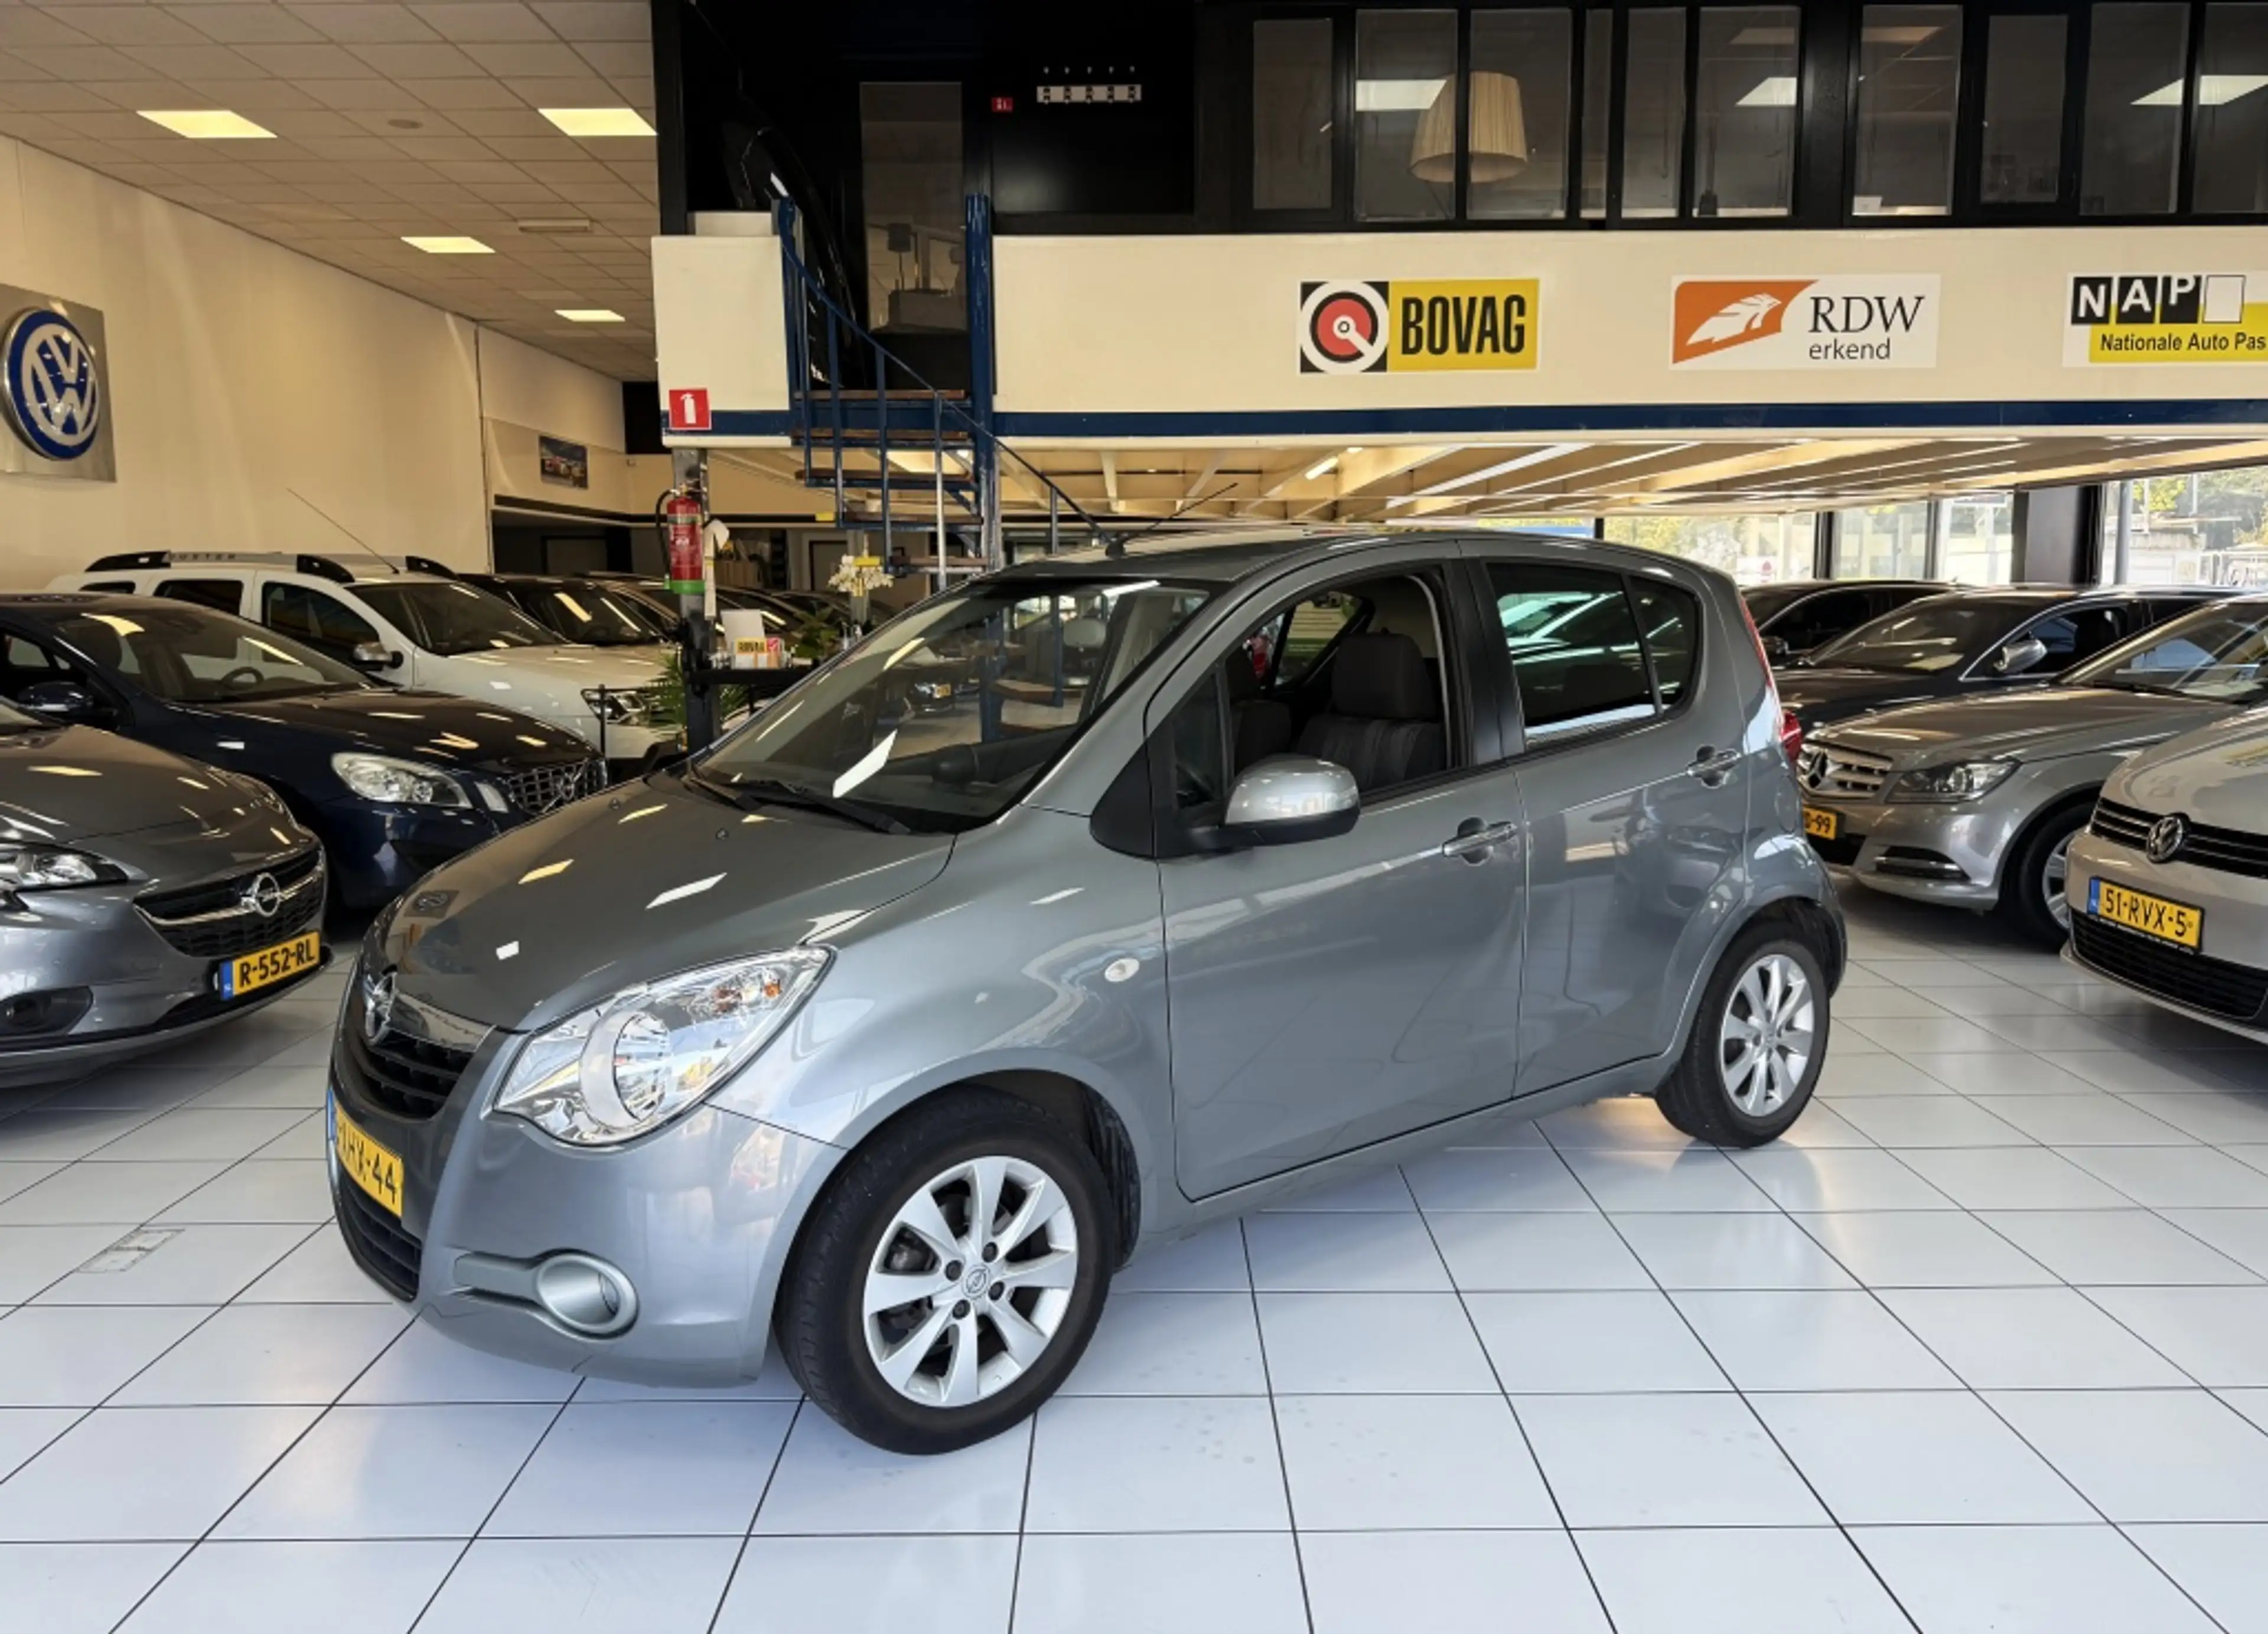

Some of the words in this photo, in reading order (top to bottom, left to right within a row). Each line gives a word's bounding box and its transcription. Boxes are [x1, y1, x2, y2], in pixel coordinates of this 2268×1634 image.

[1808, 296, 1925, 332] RDW
[2075, 275, 2197, 319] NAP
[1402, 295, 1526, 355] BOVAG
[2100, 333, 2182, 351] Nationale
[2188, 332, 2229, 351] Auto
[2234, 332, 2267, 351] Pas
[1809, 338, 1891, 360] erkend
[2106, 888, 2187, 937] 51-RVX-5
[239, 938, 315, 988] R-552-RL
